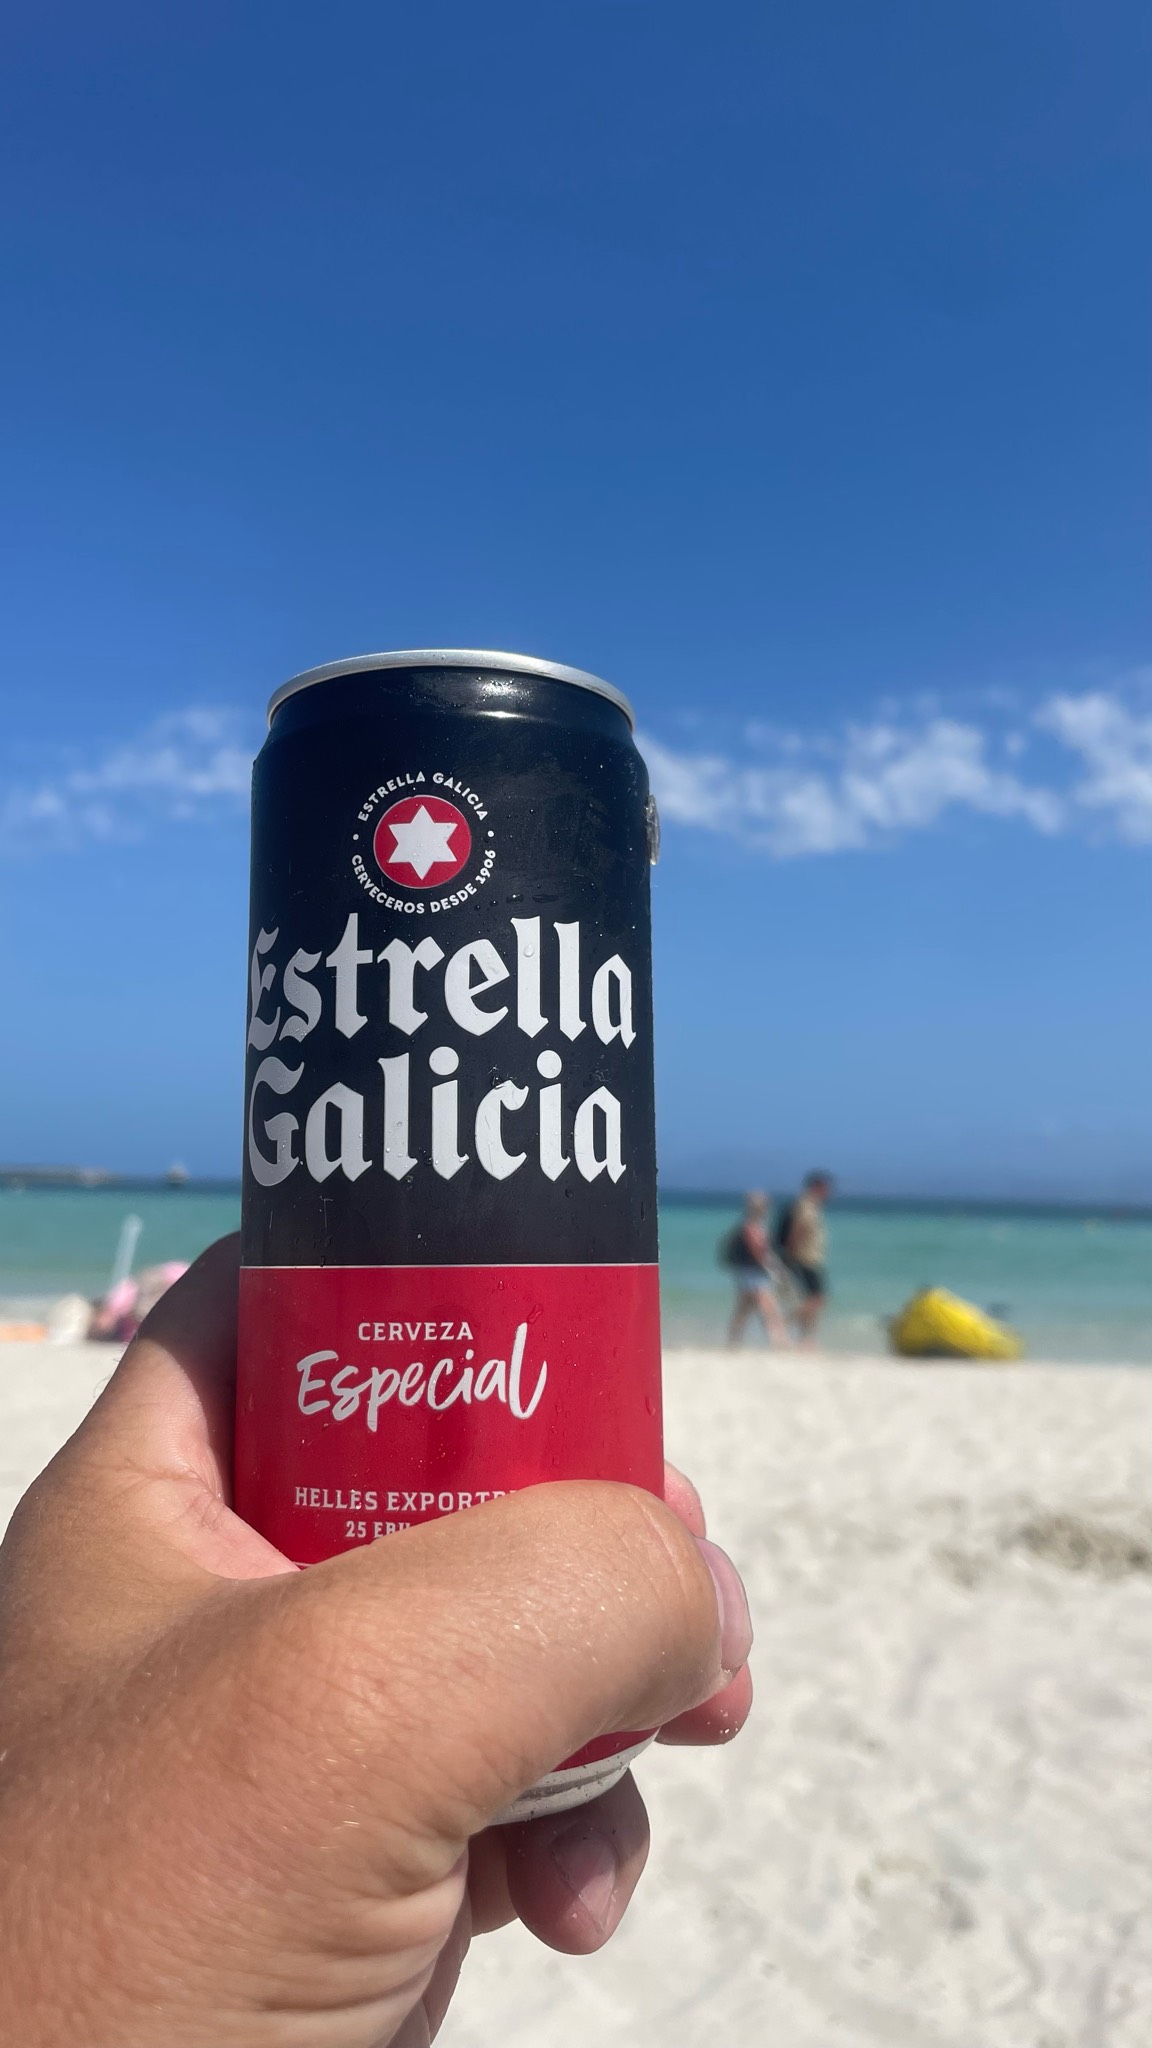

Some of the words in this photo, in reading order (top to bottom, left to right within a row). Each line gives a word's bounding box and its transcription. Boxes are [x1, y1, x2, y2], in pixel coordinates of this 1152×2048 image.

[358, 771, 426, 822] ESTRELLA
[432, 772, 488, 821] GALICIA
[351, 854, 425, 914] CERVECEROS
[430, 883, 477, 913] DESDE
[475, 850, 496, 885] 1906
[247, 912, 636, 1051] Estrella
[248, 1046, 627, 1187] Galicia
[358, 1322, 473, 1341] CERVEZA
[297, 1322, 548, 1432] Especial
[295, 1486, 378, 1511] HELLES
[345, 1521, 367, 1538] 25
